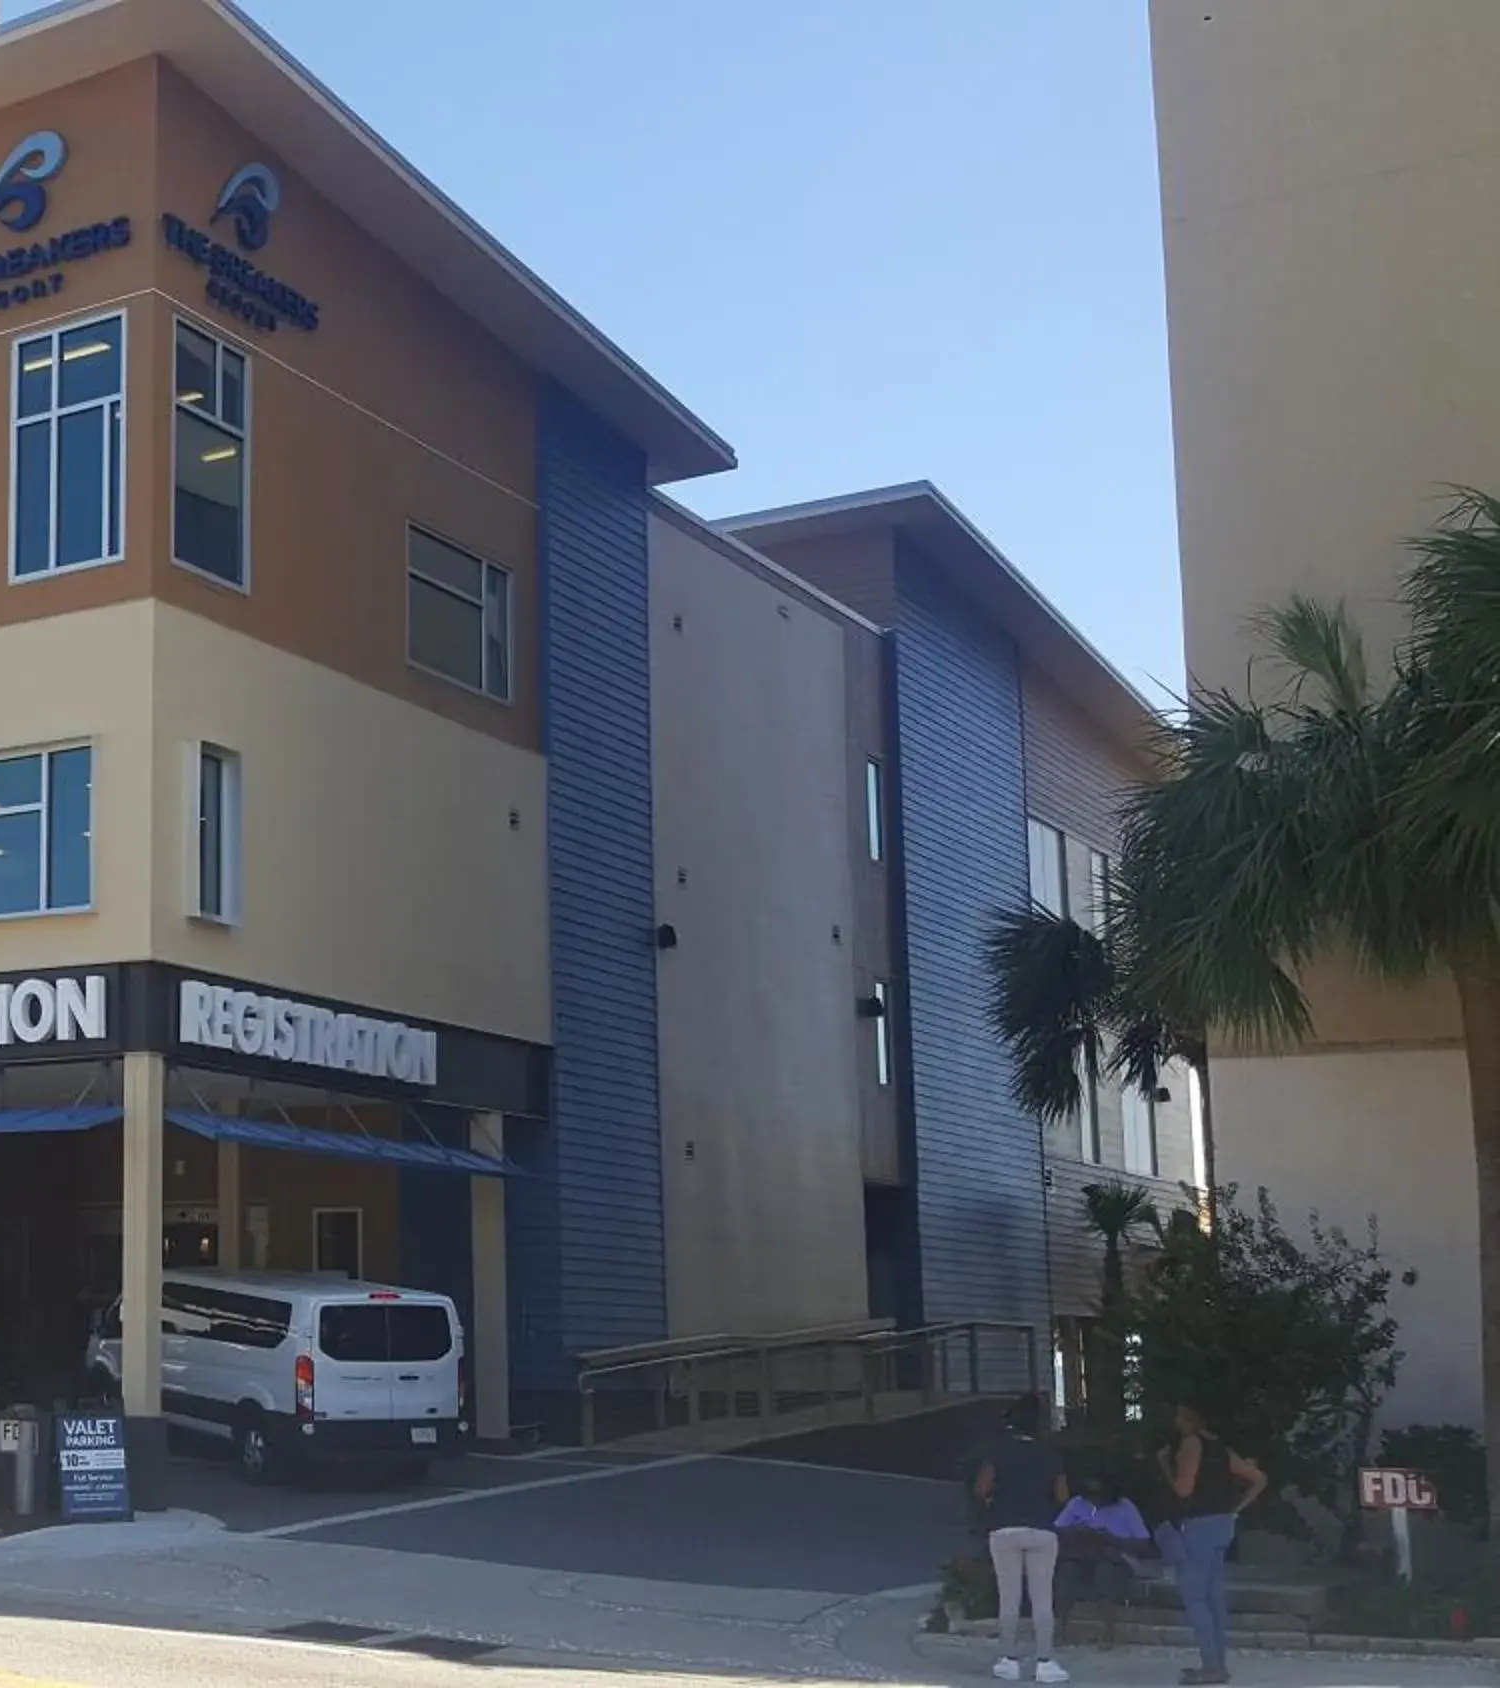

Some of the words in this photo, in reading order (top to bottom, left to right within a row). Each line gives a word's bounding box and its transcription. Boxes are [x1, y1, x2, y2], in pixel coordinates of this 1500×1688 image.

[180, 980, 437, 1085] REGISTRATION
[63, 1419, 116, 1435] VALET
[66, 1435, 116, 1447] PARKING
